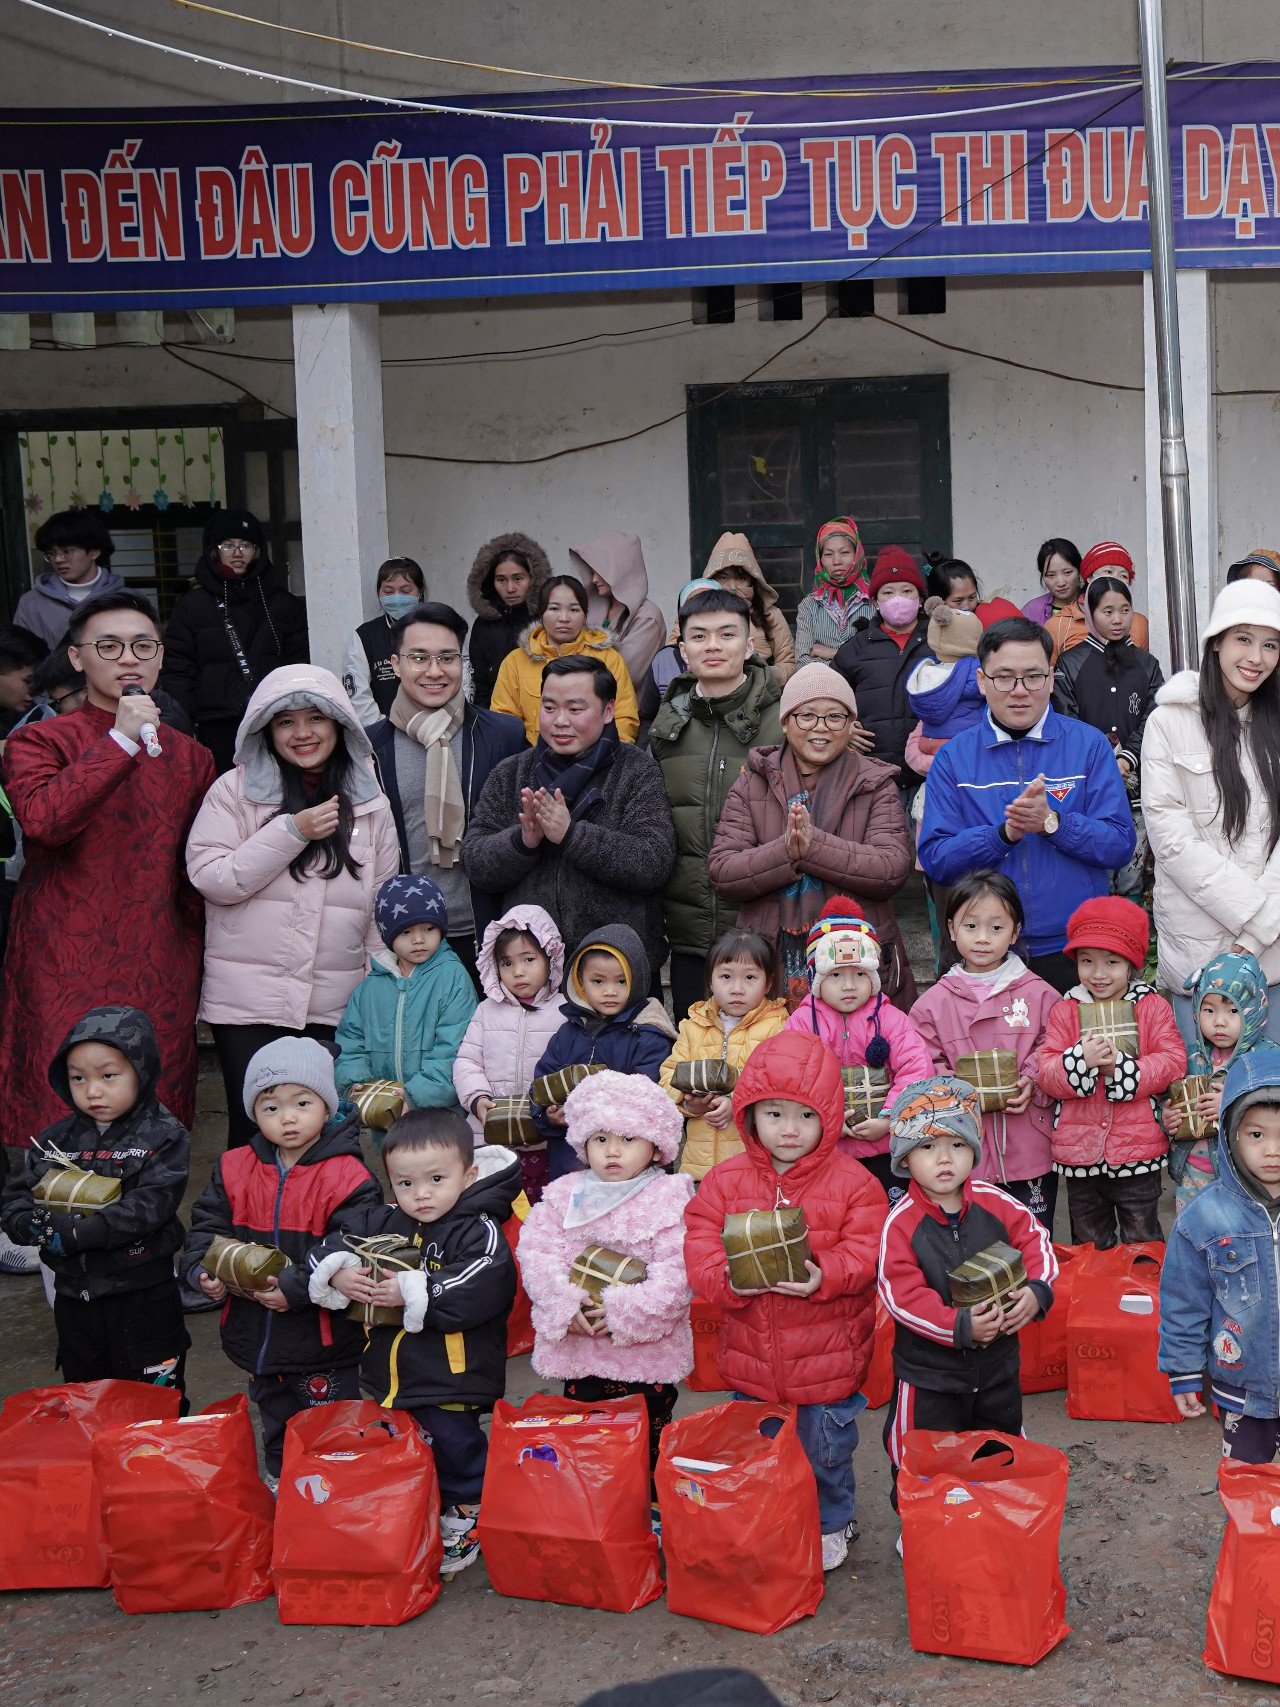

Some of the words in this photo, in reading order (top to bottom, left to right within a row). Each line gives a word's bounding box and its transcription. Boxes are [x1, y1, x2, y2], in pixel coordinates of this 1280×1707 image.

[0, 169, 52, 263] N
[61, 139, 185, 262] ĐẾN
[195, 145, 315, 260] ĐÂU
[330, 139, 489, 255] CŨNG
[504, 118, 642, 247] PHẢI
[656, 111, 786, 238] TIẾP
[801, 134, 917, 251] TỤC
[931, 130, 1029, 226] THI
[1043, 126, 1150, 223] ĐUA
[1252, 1608, 1275, 1670] COSY
